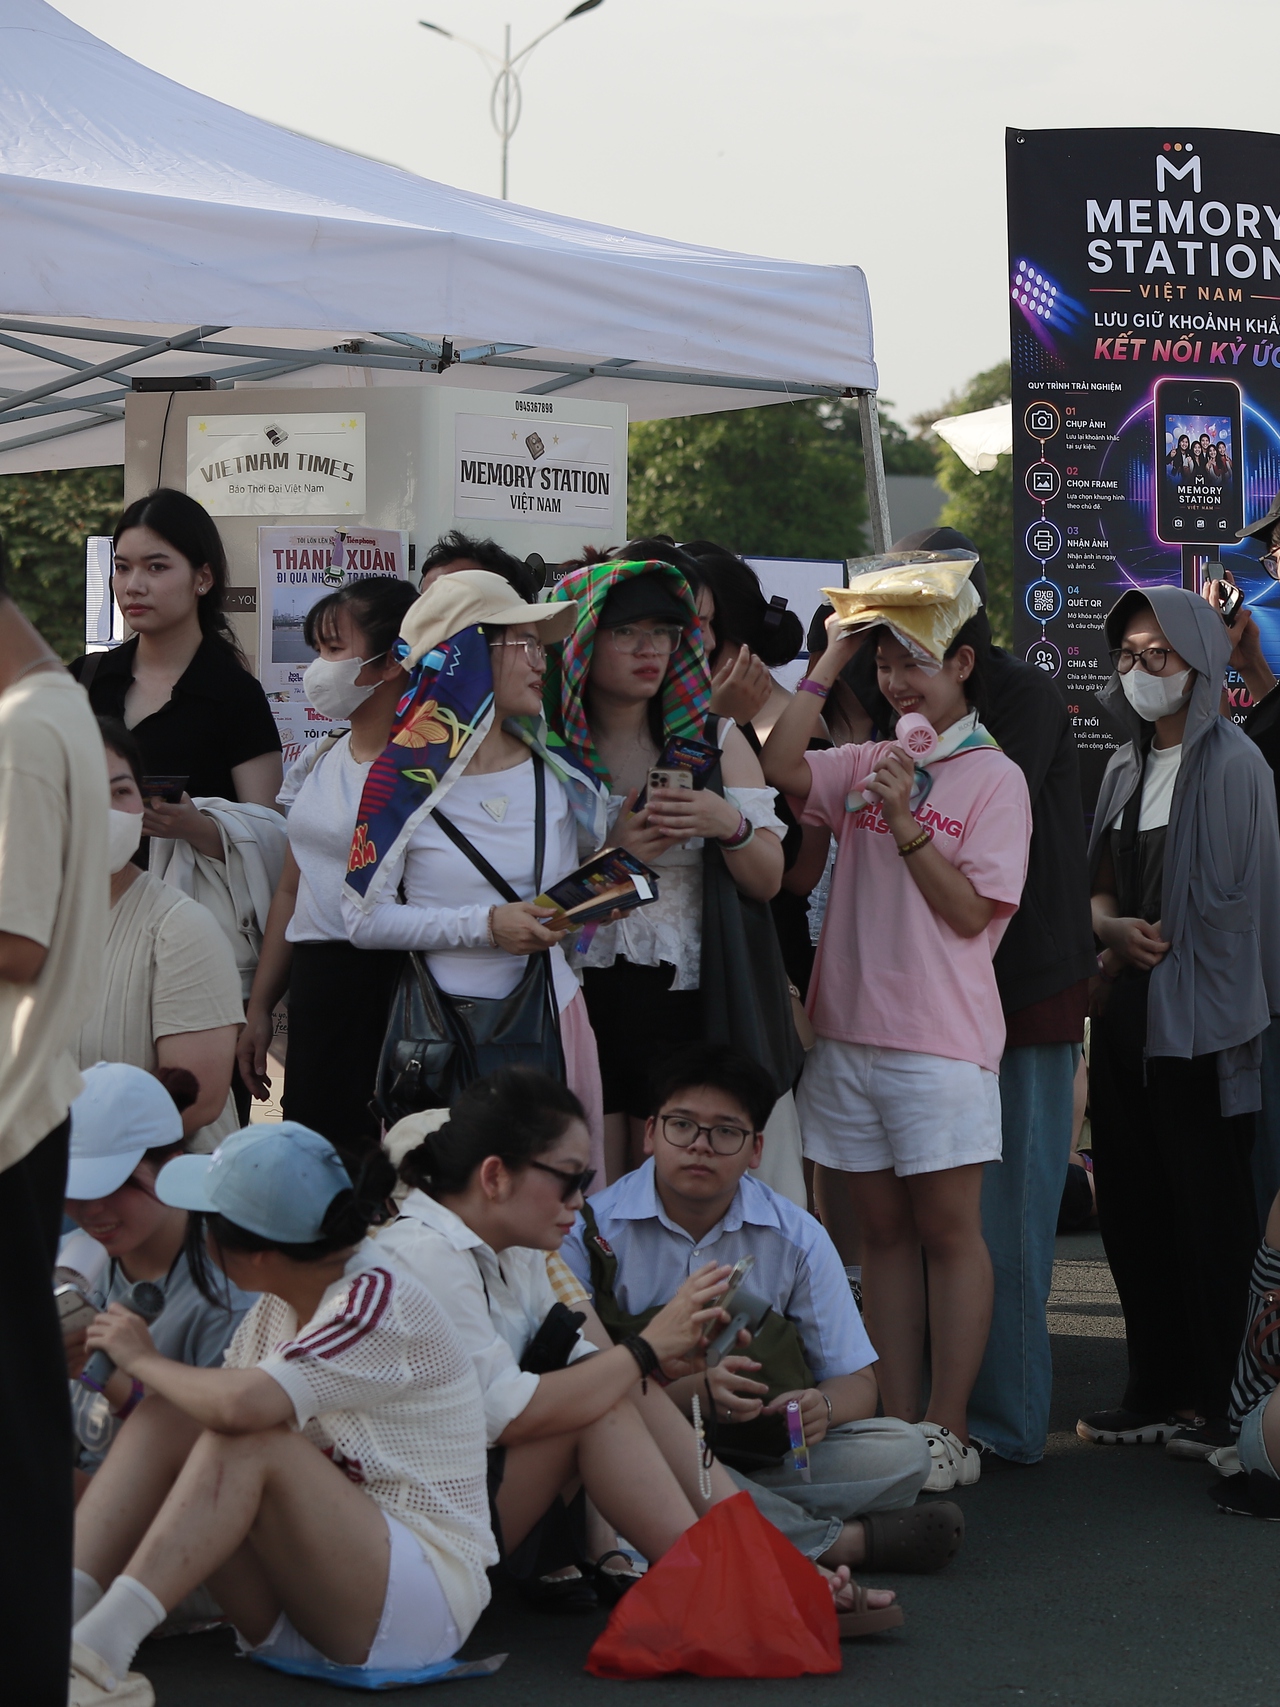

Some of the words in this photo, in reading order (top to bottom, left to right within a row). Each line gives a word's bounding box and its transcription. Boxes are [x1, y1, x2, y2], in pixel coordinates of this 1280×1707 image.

[1139, 281, 1187, 302] VIỆT
[1198, 287, 1243, 302] NAM
[1094, 311, 1128, 328] LƯU
[1133, 310, 1164, 328] GIỮ
[1169, 312, 1241, 332] KHOẢNH
[1094, 330, 1147, 361] KẾT
[1152, 332, 1202, 363] NỐI
[1209, 335, 1247, 365] KỶ
[1027, 381, 1045, 392] QUY
[1046, 380, 1070, 392] TRÌNH
[1070, 380, 1090, 392] TRẢI
[1090, 382, 1122, 393] NGHIỆM
[1065, 407, 1076, 415] 01
[1066, 420, 1088, 430] CHỤP
[1089, 418, 1106, 429] ẢNH
[1077, 433, 1085, 441] lại
[1085, 433, 1106, 441] khoảnh
[200, 452, 289, 483] VIETNAM
[296, 452, 355, 482] TIMES
[1066, 467, 1078, 475] 02
[460, 459, 537, 489] MEMORY
[540, 467, 610, 495] STATION
[229, 484, 245, 494] Báo
[248, 484, 266, 493] Thời
[268, 484, 283, 494] Đại
[284, 484, 301, 494] Việt
[304, 484, 325, 493] Nam
[1066, 480, 1090, 489] CHỌN
[1091, 480, 1118, 488] FRAME
[1177, 485, 1222, 495] MEMORY
[1093, 493, 1112, 501] khung
[1179, 495, 1221, 504] STATION
[510, 492, 535, 514] VIỆT
[536, 497, 561, 513] NAM
[1067, 526, 1079, 535] 03
[1067, 538, 1090, 549] NHẬN
[1091, 538, 1109, 548] ẢNH
[346, 547, 397, 572] XUÂN
[276, 572, 287, 583] ĐI
[289, 572, 308, 585] QUA
[1067, 586, 1079, 594] 04
[1067, 598, 1090, 607] QUÉT
[1090, 599, 1102, 607] QR
[1092, 612, 1102, 620] nội
[1086, 623, 1104, 631] chuyệ
[1067, 647, 1079, 655] 05
[1067, 660, 1087, 668] CHIA
[1088, 658, 1098, 668] SẺ
[1086, 684, 1095, 692] giữ
[1067, 705, 1079, 713] 06
[1070, 716, 1082, 726] ẾT
[1084, 716, 1099, 726] NỐI
[304, 729, 320, 738] TÔI
[1087, 731, 1100, 739] cảm
